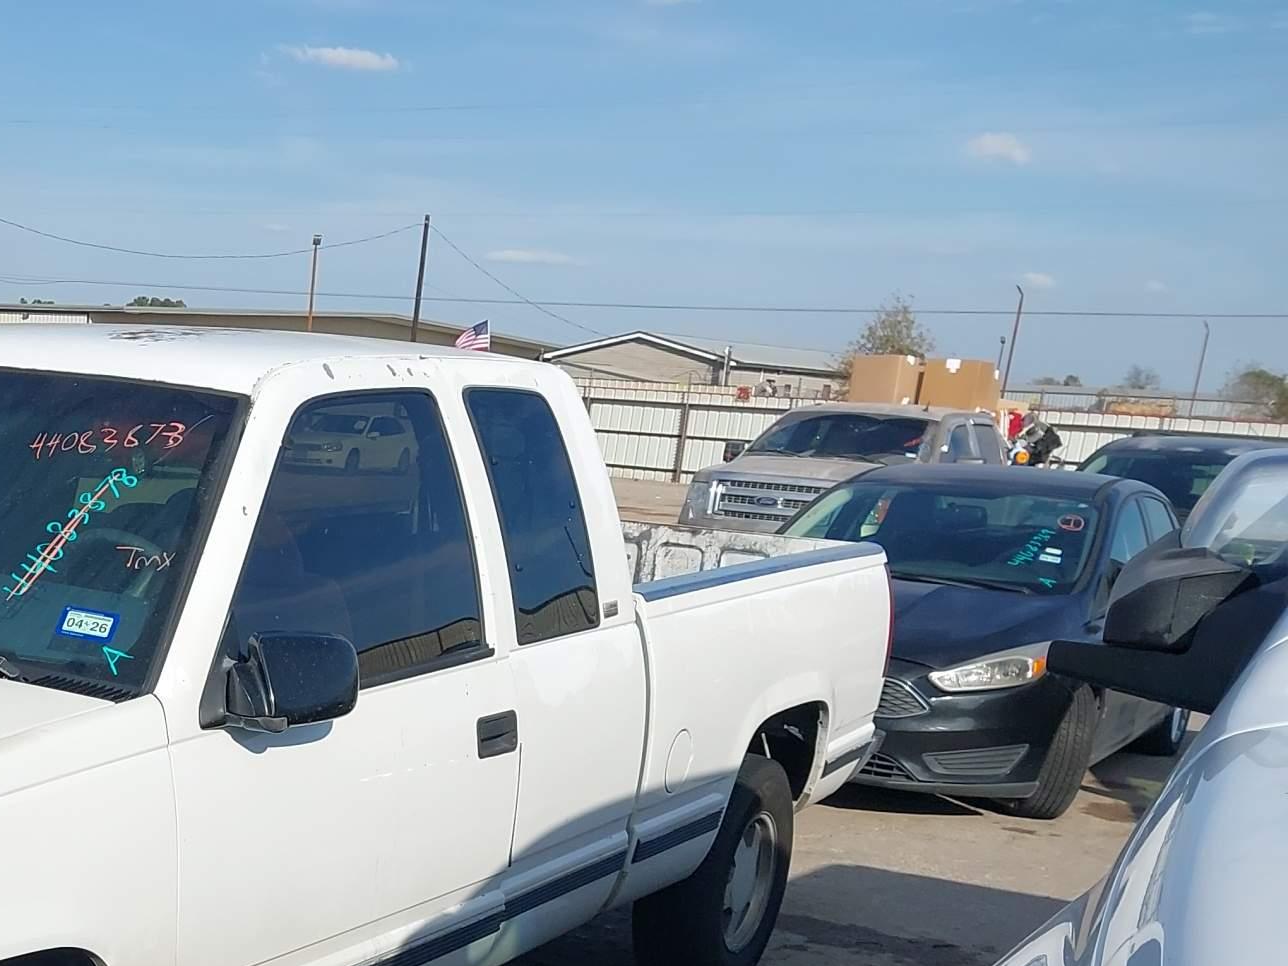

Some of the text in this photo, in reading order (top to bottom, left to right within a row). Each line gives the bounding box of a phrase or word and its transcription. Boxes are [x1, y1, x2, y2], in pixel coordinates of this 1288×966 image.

[66, 617, 109, 633] 04 26
[102, 645, 135, 676] A
